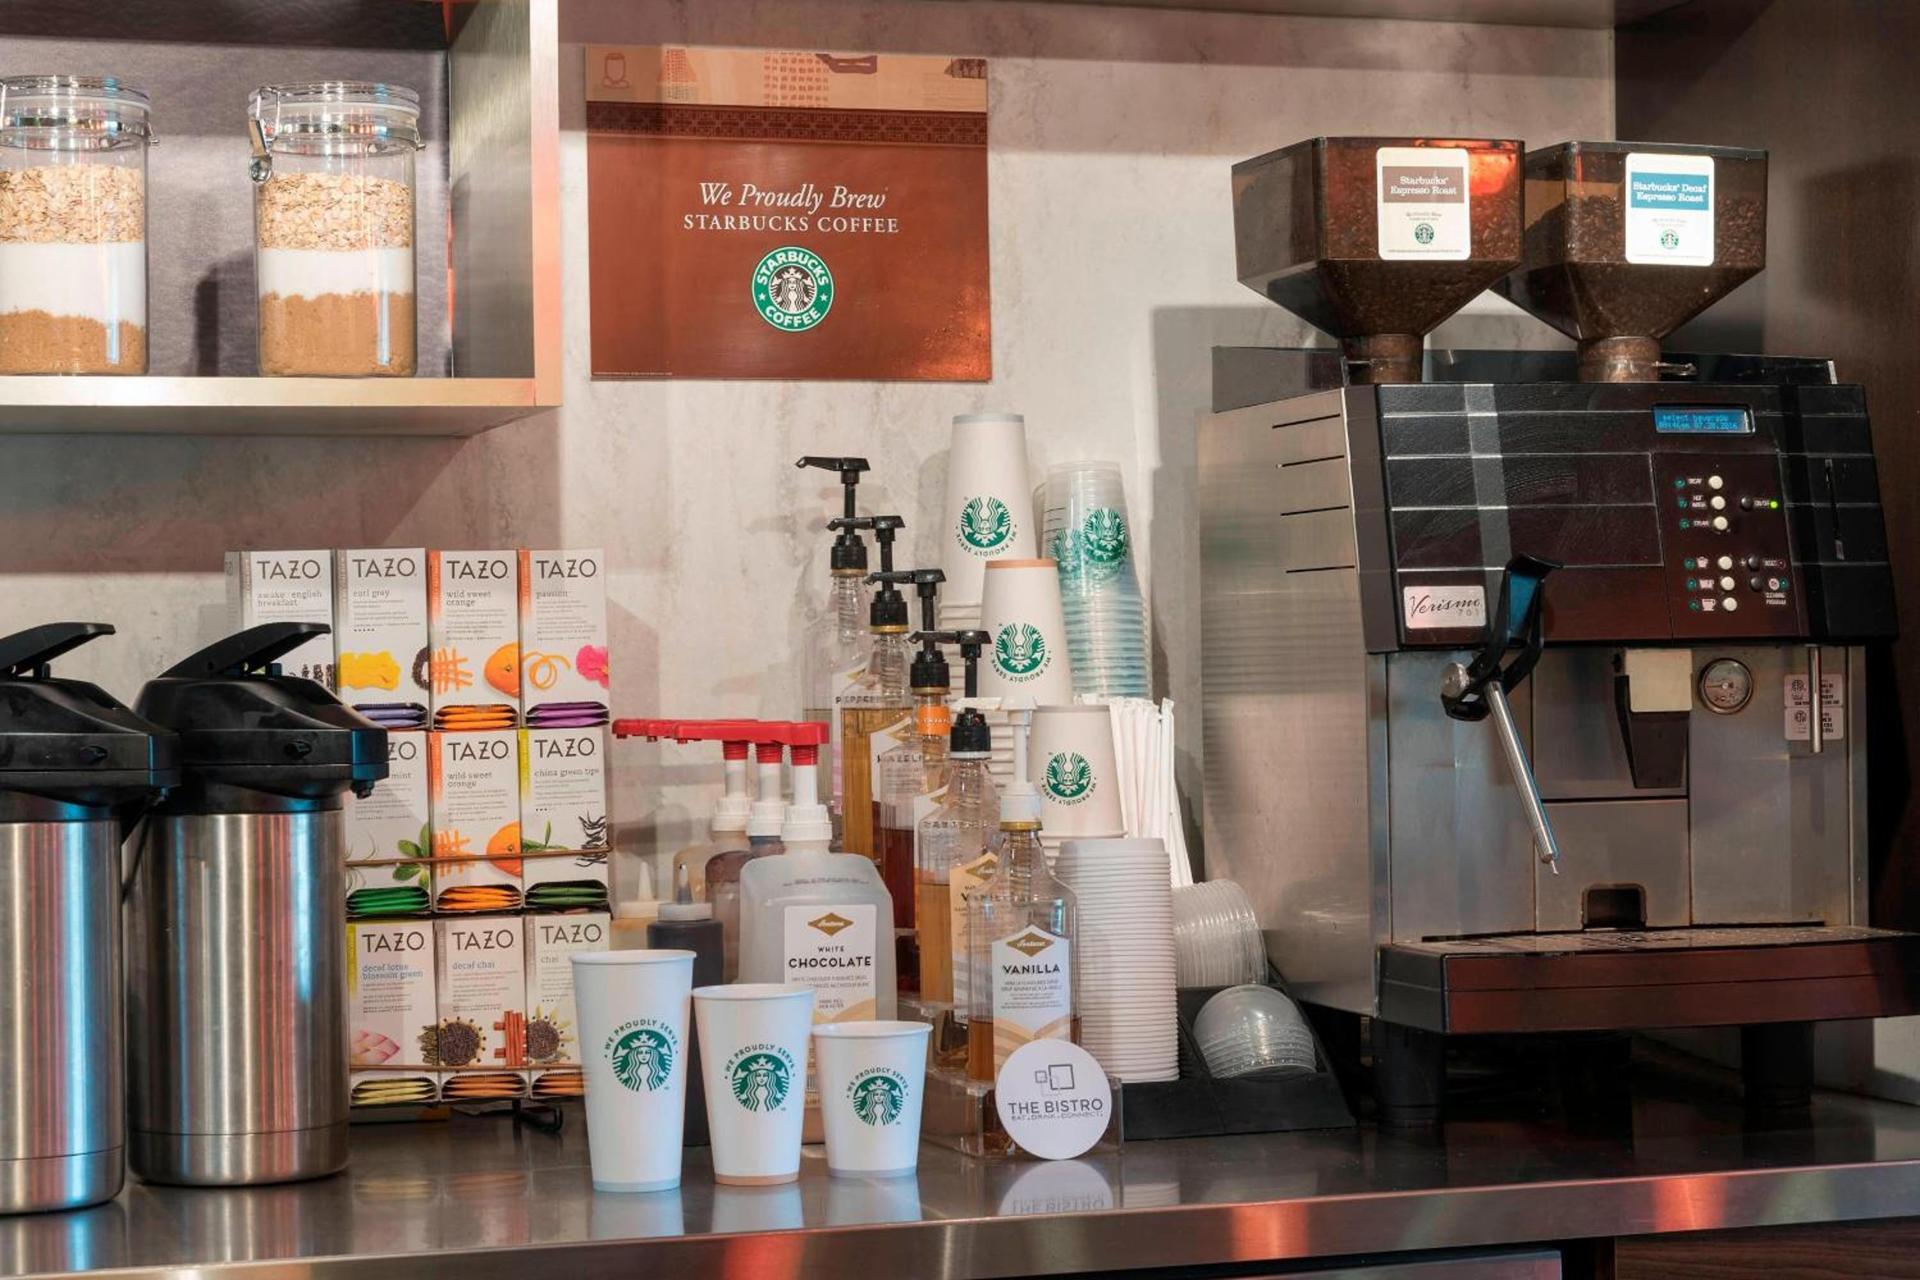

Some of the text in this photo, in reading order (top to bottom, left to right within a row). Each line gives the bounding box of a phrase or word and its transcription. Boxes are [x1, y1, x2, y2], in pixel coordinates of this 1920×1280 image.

[699, 182, 886, 215] We Proudly Brew
[683, 214, 900, 233] STARBUCKS COFFEE
[756, 250, 830, 286] STARBUCKS
[765, 306, 821, 328] COFFEE
[257, 560, 320, 580] TAZO
[353, 558, 415, 578] TAZO
[446, 560, 507, 579] TAZO
[536, 559, 596, 578] TAZO
[446, 590, 491, 599] wild sweet
[446, 599, 476, 608] orange
[388, 741, 417, 760] ZO
[448, 741, 508, 760] TAZO
[535, 738, 594, 757] TAZO
[448, 772, 466, 780] wild
[362, 932, 424, 952] TAZO
[452, 930, 514, 950] TAZO
[541, 924, 601, 944] TAZO
[789, 956, 871, 969] CHOCOLATE
[1002, 964, 1061, 975] VANILLA
[604, 1018, 678, 1050] WE PROUDLY SERVE
[726, 1043, 795, 1072] WE PROUDLY SERVE
[847, 1067, 909, 1092] WE PROUDLY SERVE
[1008, 1098, 1103, 1114] THE BISTRO
